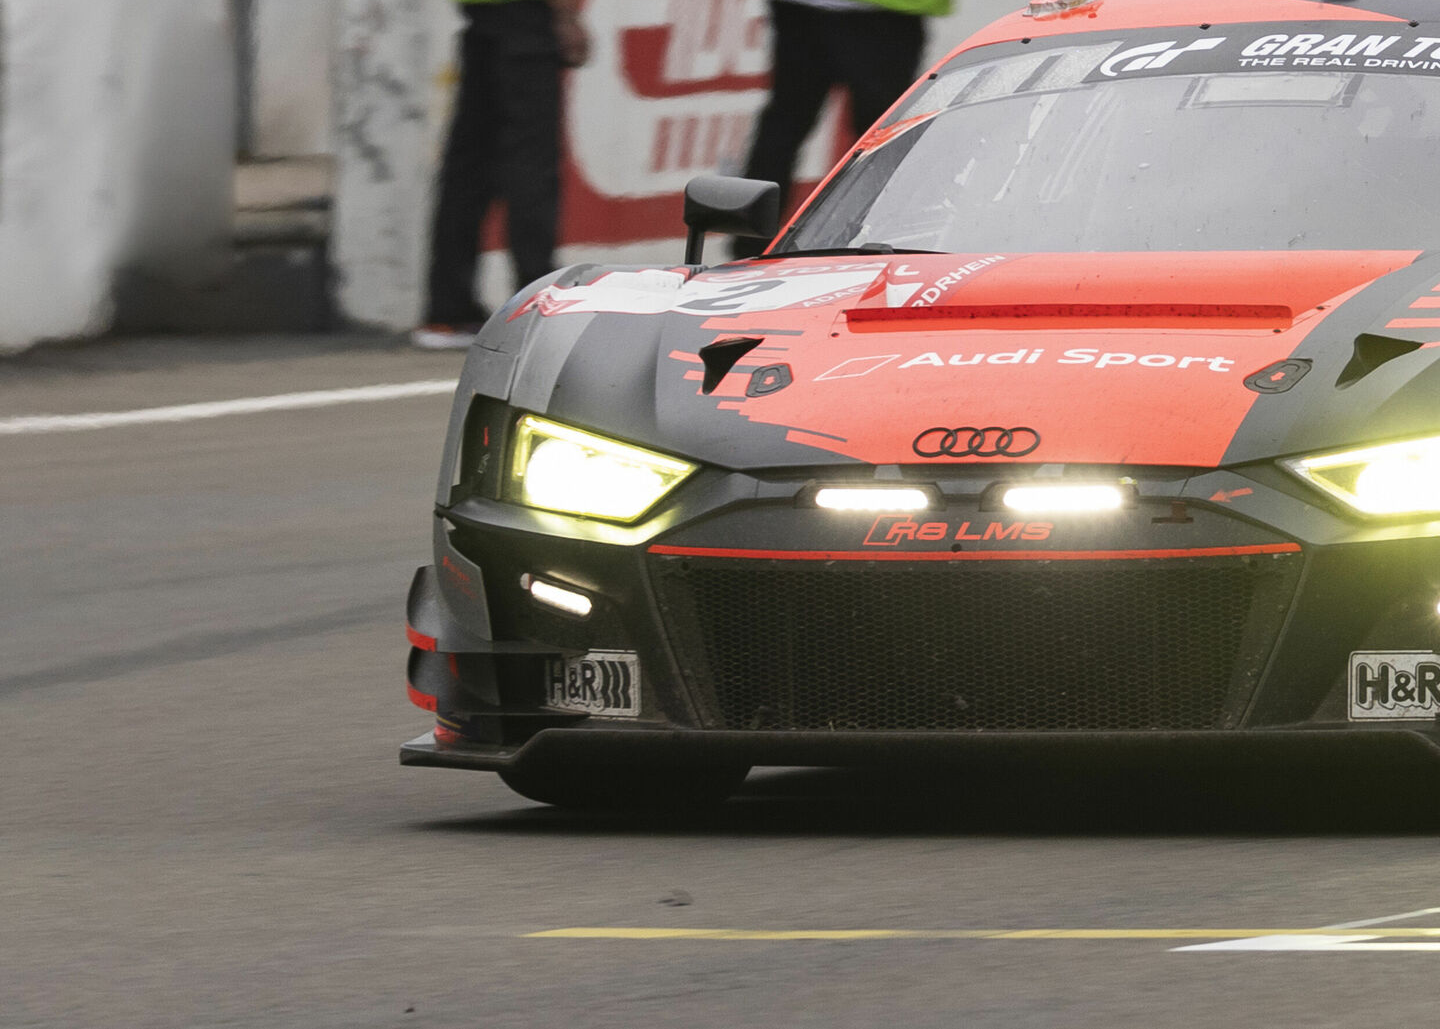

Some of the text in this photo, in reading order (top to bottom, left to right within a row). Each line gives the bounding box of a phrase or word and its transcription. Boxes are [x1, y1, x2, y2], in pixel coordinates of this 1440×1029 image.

[1241, 33, 1401, 57] GRAN
[1238, 58, 1284, 67] THE
[1291, 57, 1358, 68] REAL
[679, 278, 786, 311] 2
[897, 348, 1235, 372] Audi Sport
[885, 522, 1054, 540] R8 LMS
[546, 659, 605, 707] H&R
